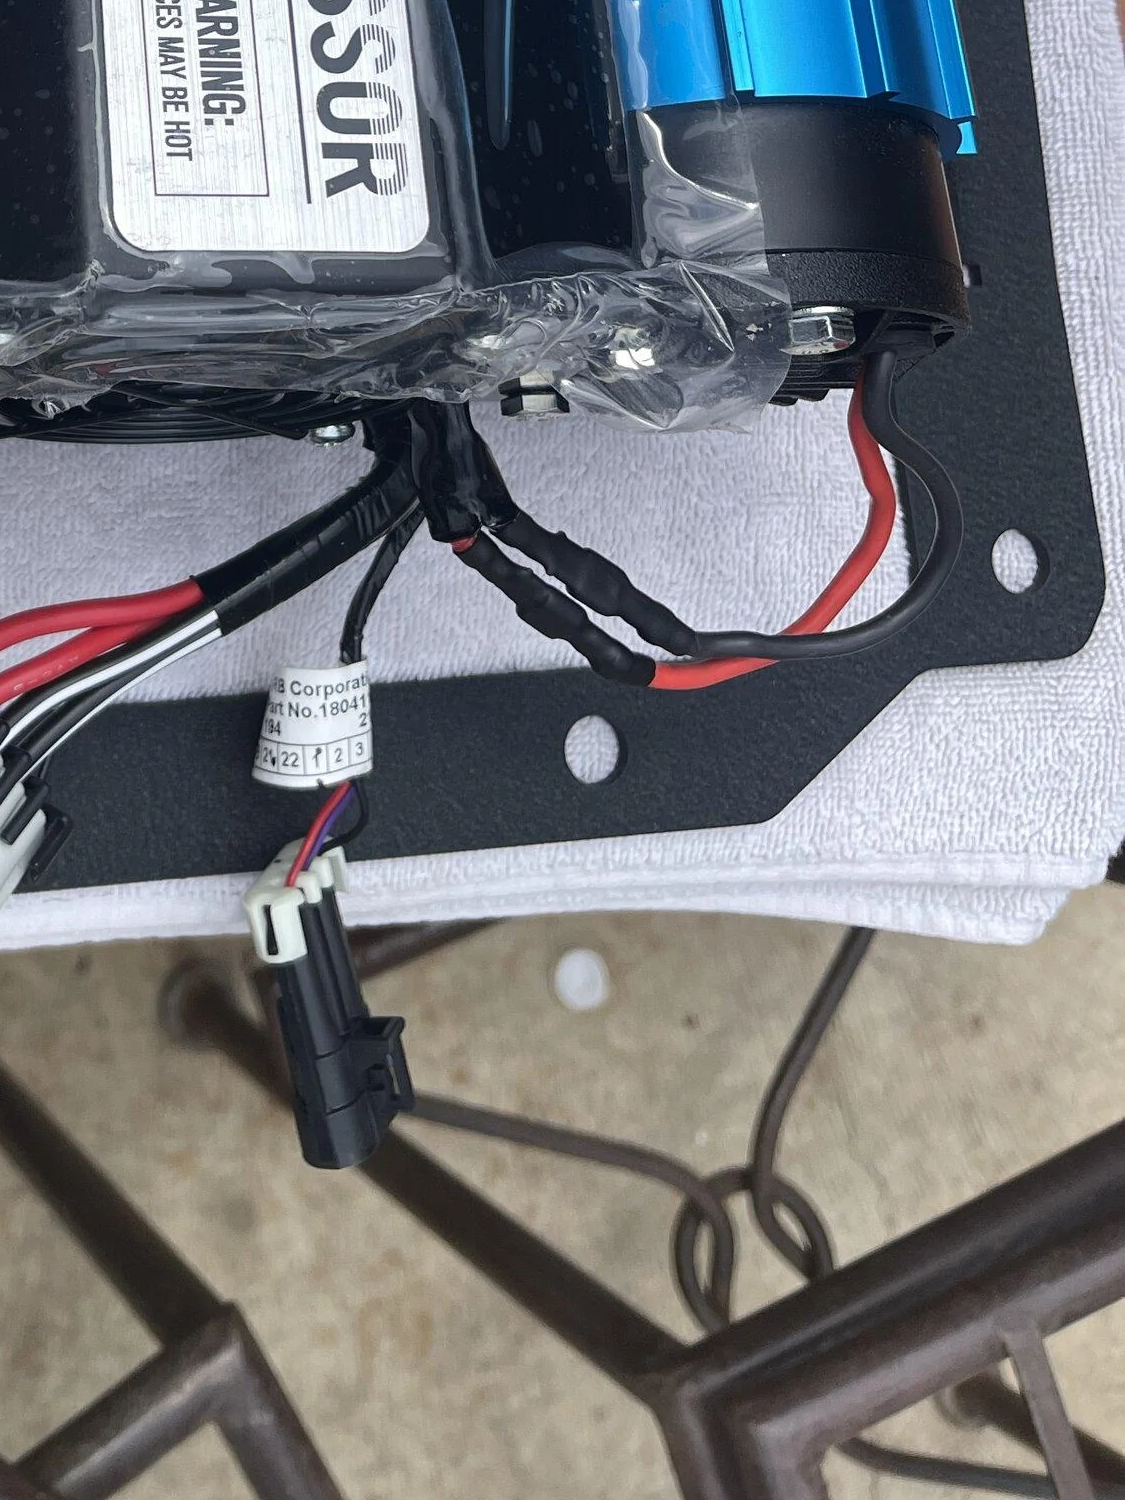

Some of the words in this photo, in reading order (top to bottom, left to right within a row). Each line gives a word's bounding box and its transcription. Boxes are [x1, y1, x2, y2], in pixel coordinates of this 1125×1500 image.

[157, 37, 187, 81] MAY
[162, 86, 190, 113] BE
[164, 120, 193, 162] HOT
[281, 751, 299, 767] 22
[334, 748, 343, 763] 2
[355, 742, 364, 757] 3
